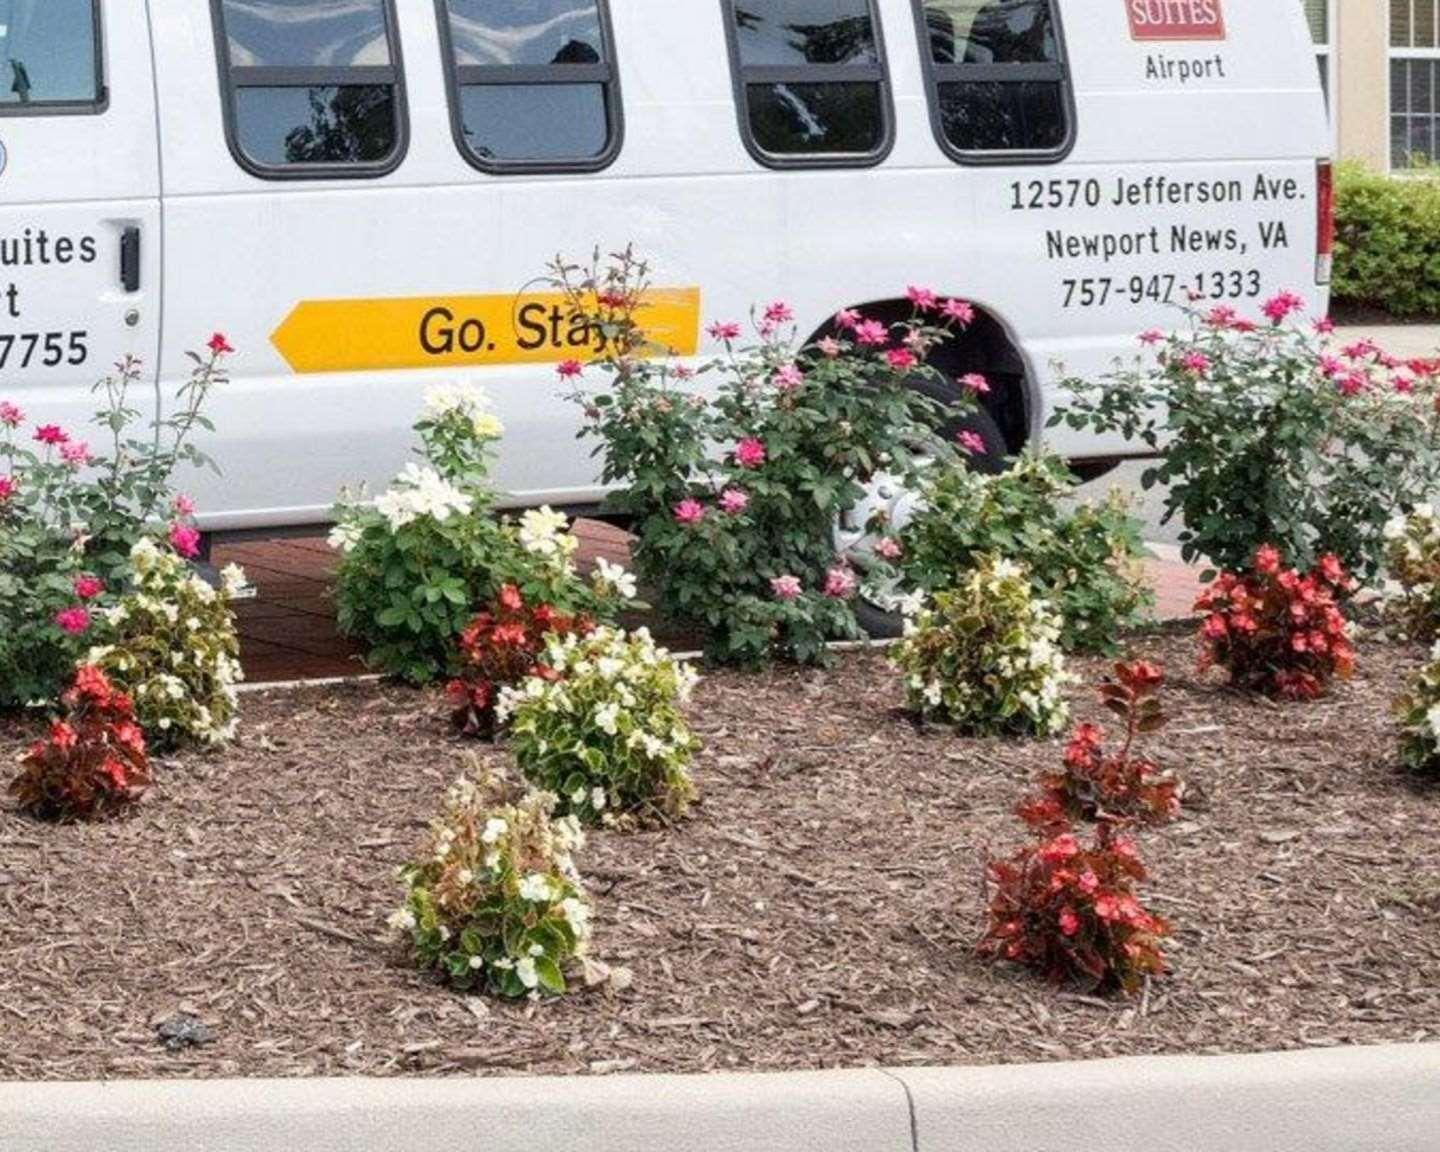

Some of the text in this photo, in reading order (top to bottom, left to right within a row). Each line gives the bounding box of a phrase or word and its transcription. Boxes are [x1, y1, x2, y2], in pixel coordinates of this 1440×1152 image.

[1132, 0, 1216, 25] SUITES
[1146, 55, 1225, 83] Airport
[1011, 174, 1306, 210] 12570 Jefferson Ave.
[1046, 221, 1288, 262] Newport News, VA
[1062, 269, 1262, 308] 757-947-1333
[419, 307, 496, 355] Go.
